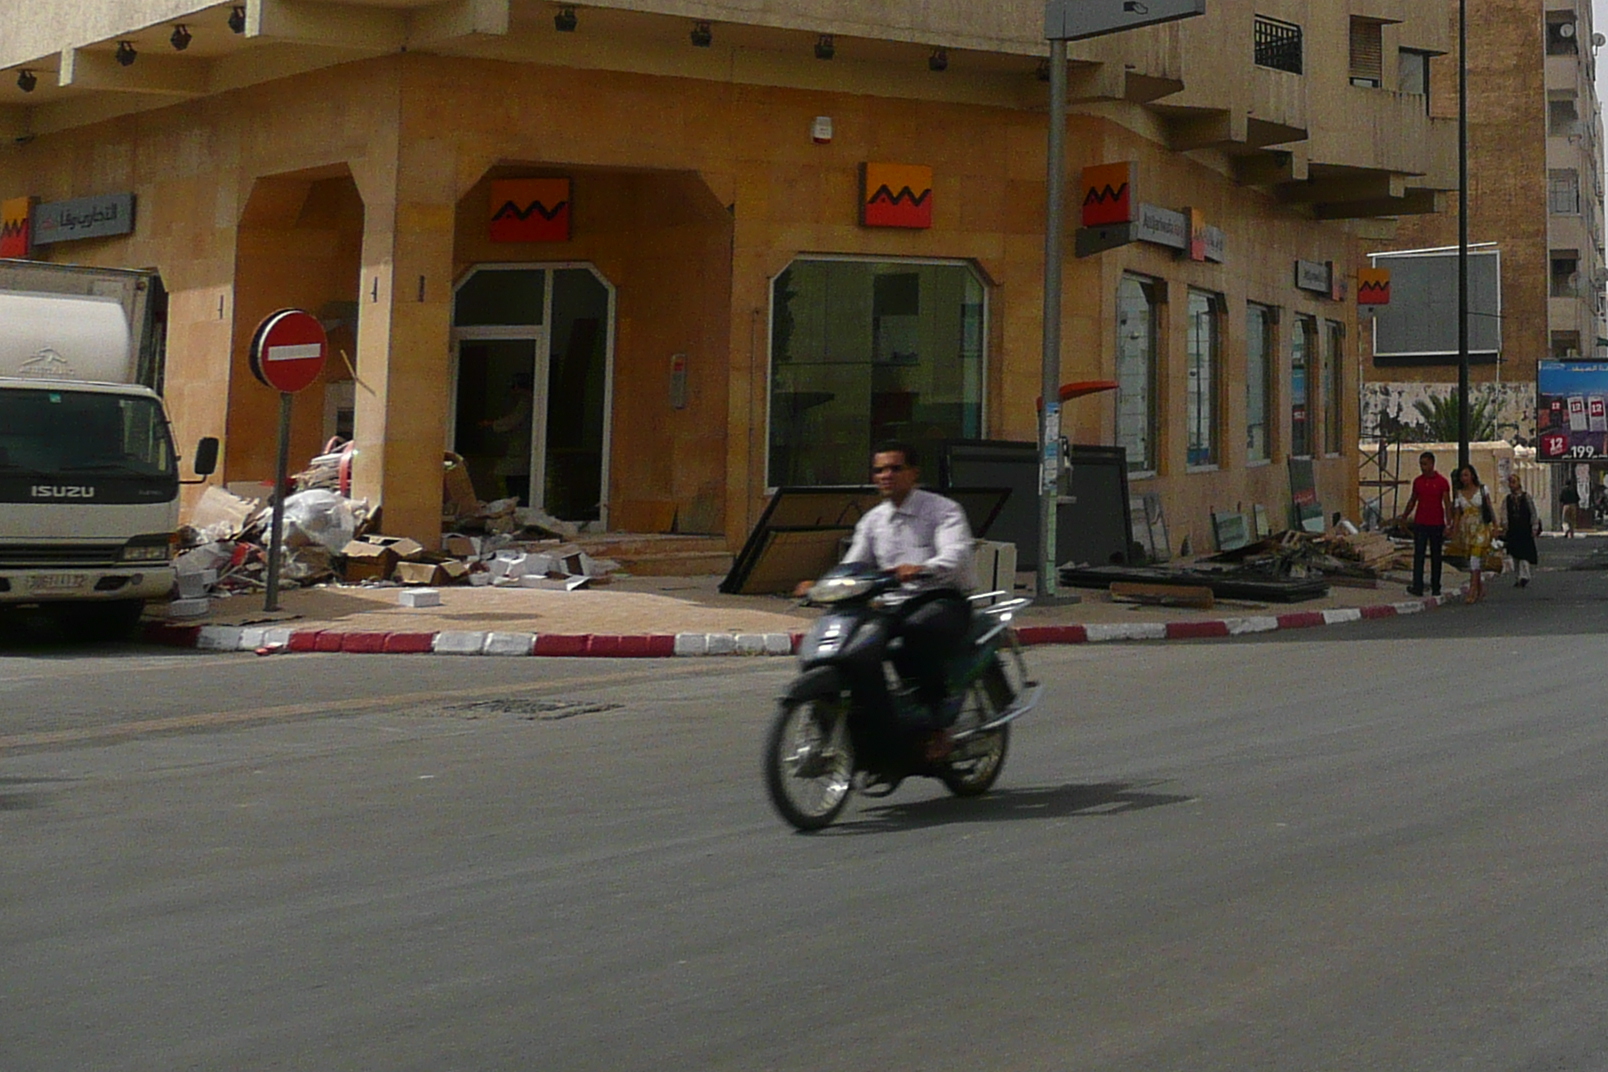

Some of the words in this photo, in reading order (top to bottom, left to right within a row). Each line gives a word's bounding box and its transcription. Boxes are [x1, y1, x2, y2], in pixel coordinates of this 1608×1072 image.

[1551, 401, 1561, 410] 12
[1571, 402, 1581, 412] 12
[1591, 403, 1602, 413] 12
[1549, 437, 1563, 452] 12
[1570, 445, 1595, 459] 199
[31, 485, 95, 498] ISUZU
